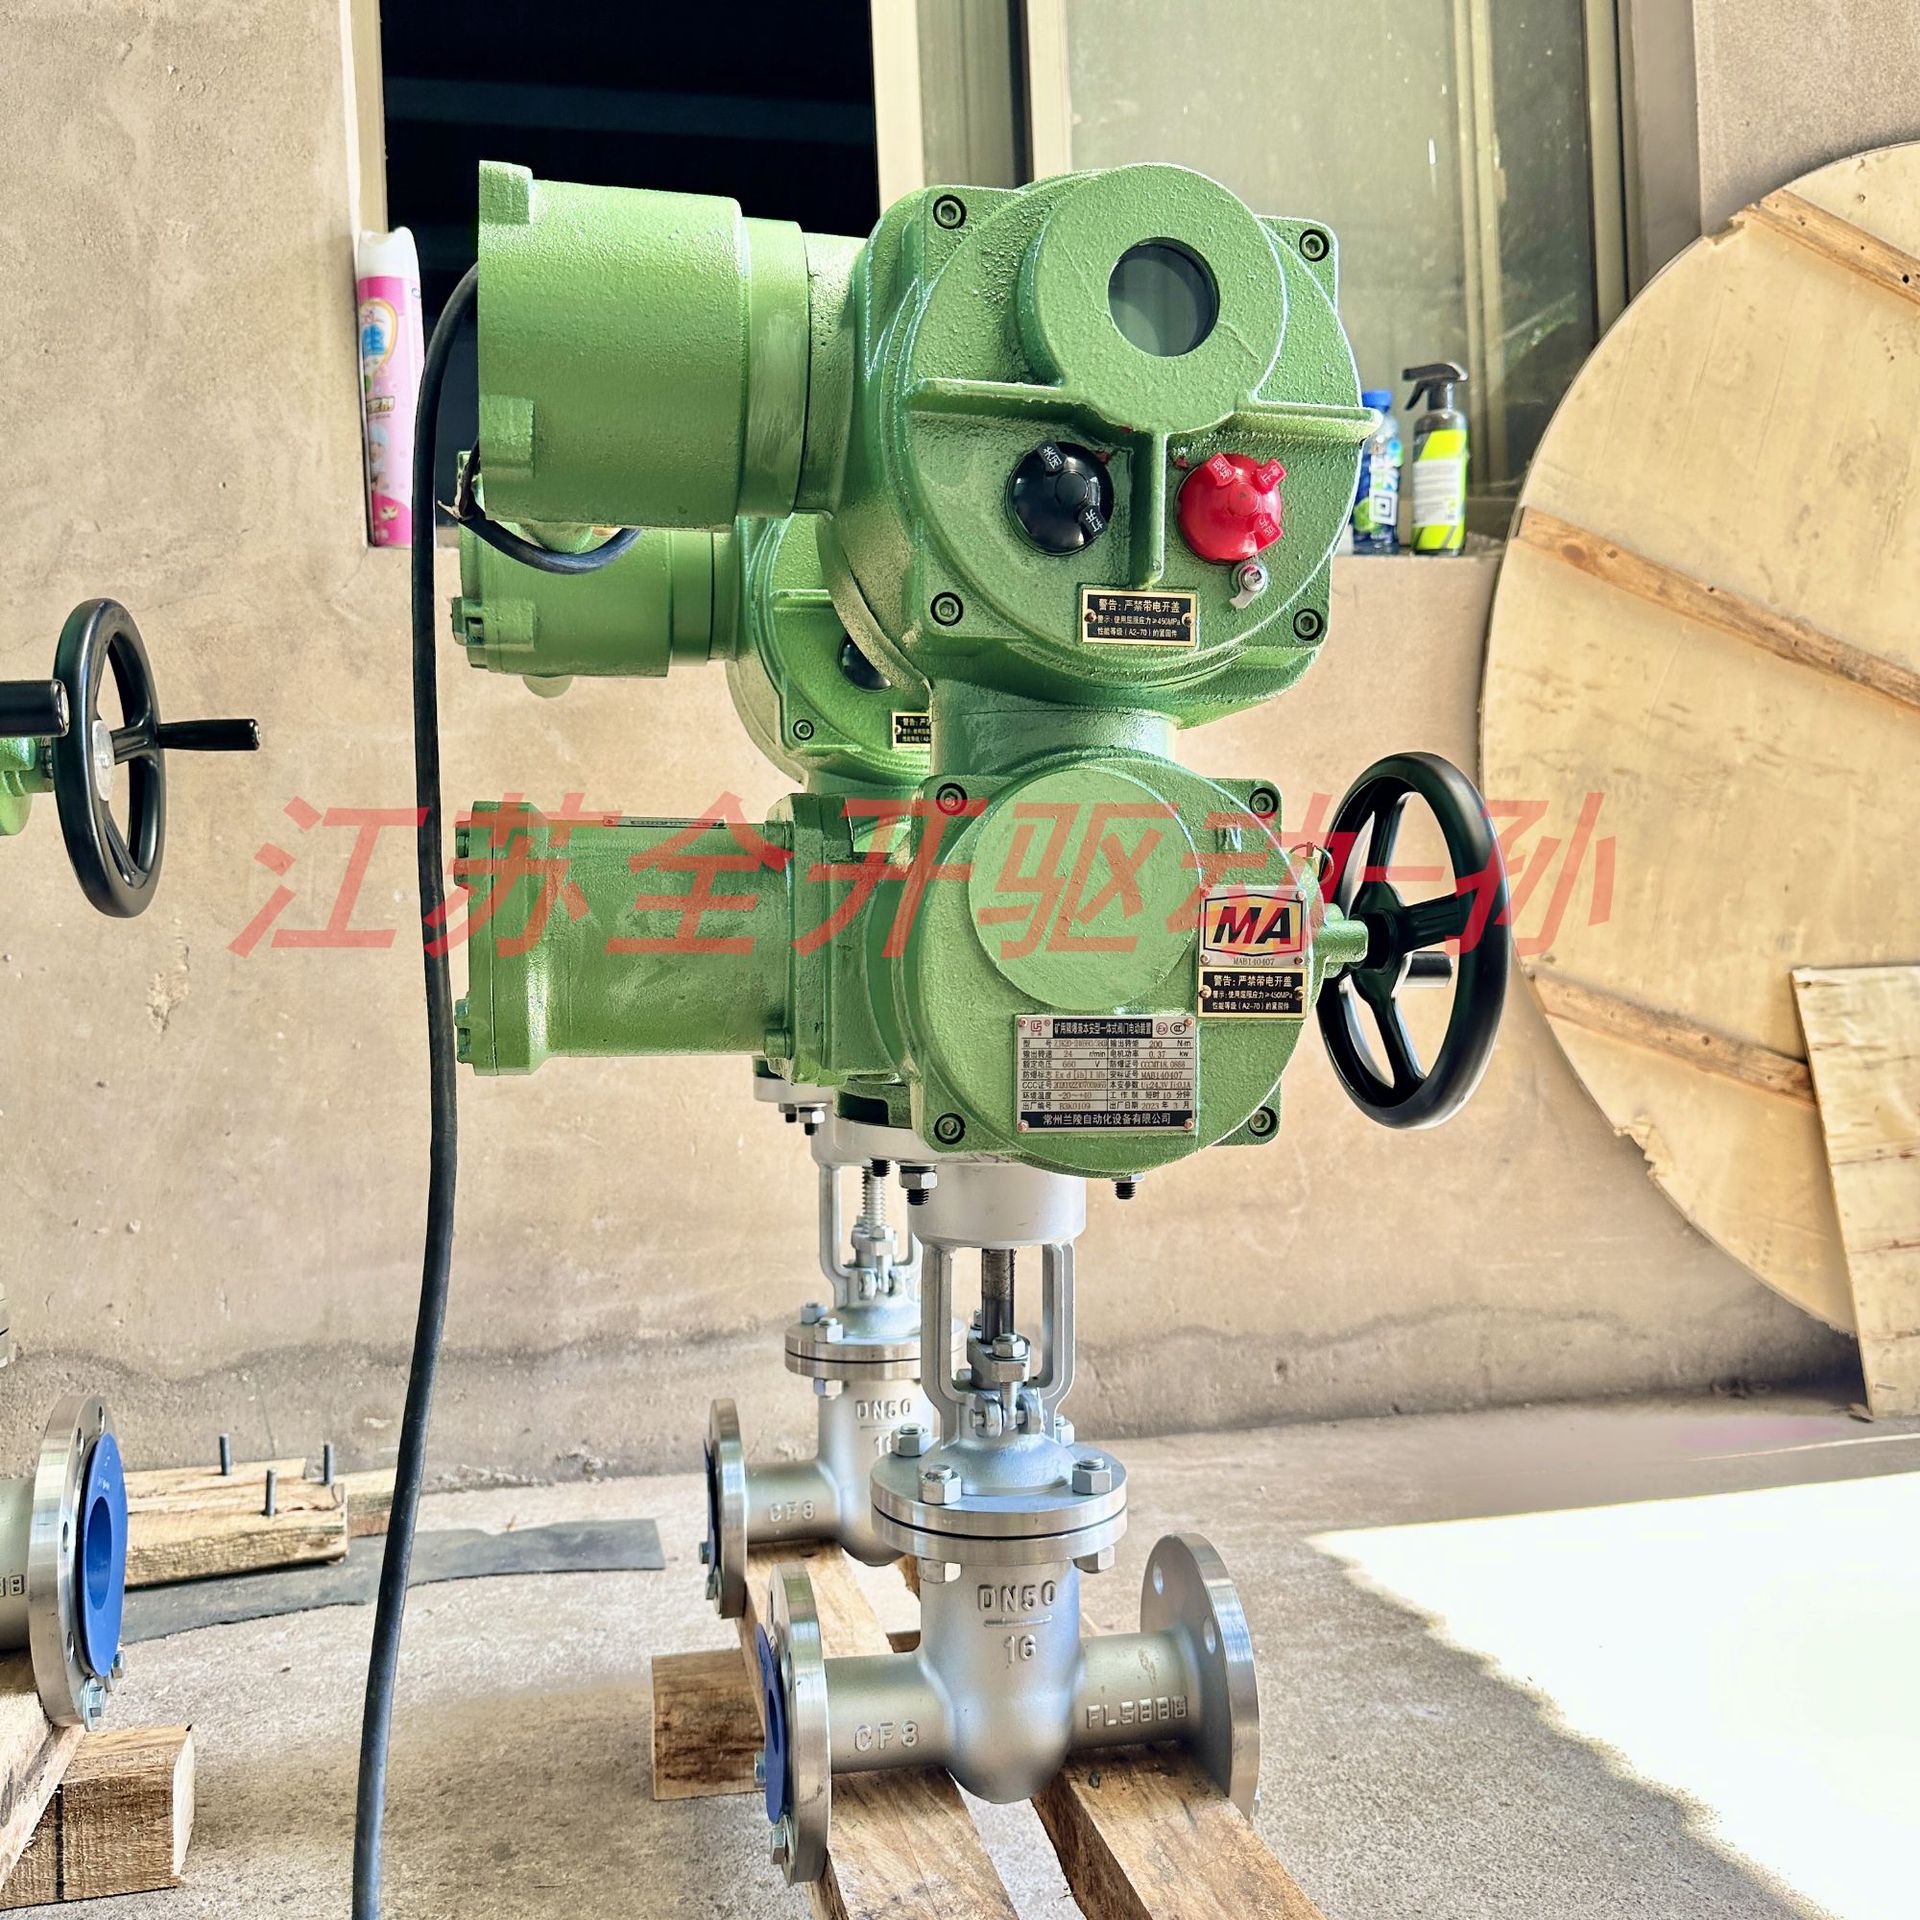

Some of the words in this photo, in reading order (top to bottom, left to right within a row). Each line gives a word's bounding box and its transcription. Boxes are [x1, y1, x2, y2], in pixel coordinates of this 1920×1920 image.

[1043, 446, 1062, 469] 关闭
[1085, 508, 1103, 532] 打开
[1212, 906, 1291, 944] MA
[1043, 1113, 1171, 1126] 常州兰陵自动化设备有限公司
[977, 1579, 1057, 1613] DN50
[1003, 1633, 1037, 1665] 16
[854, 1719, 920, 1753] CF8
